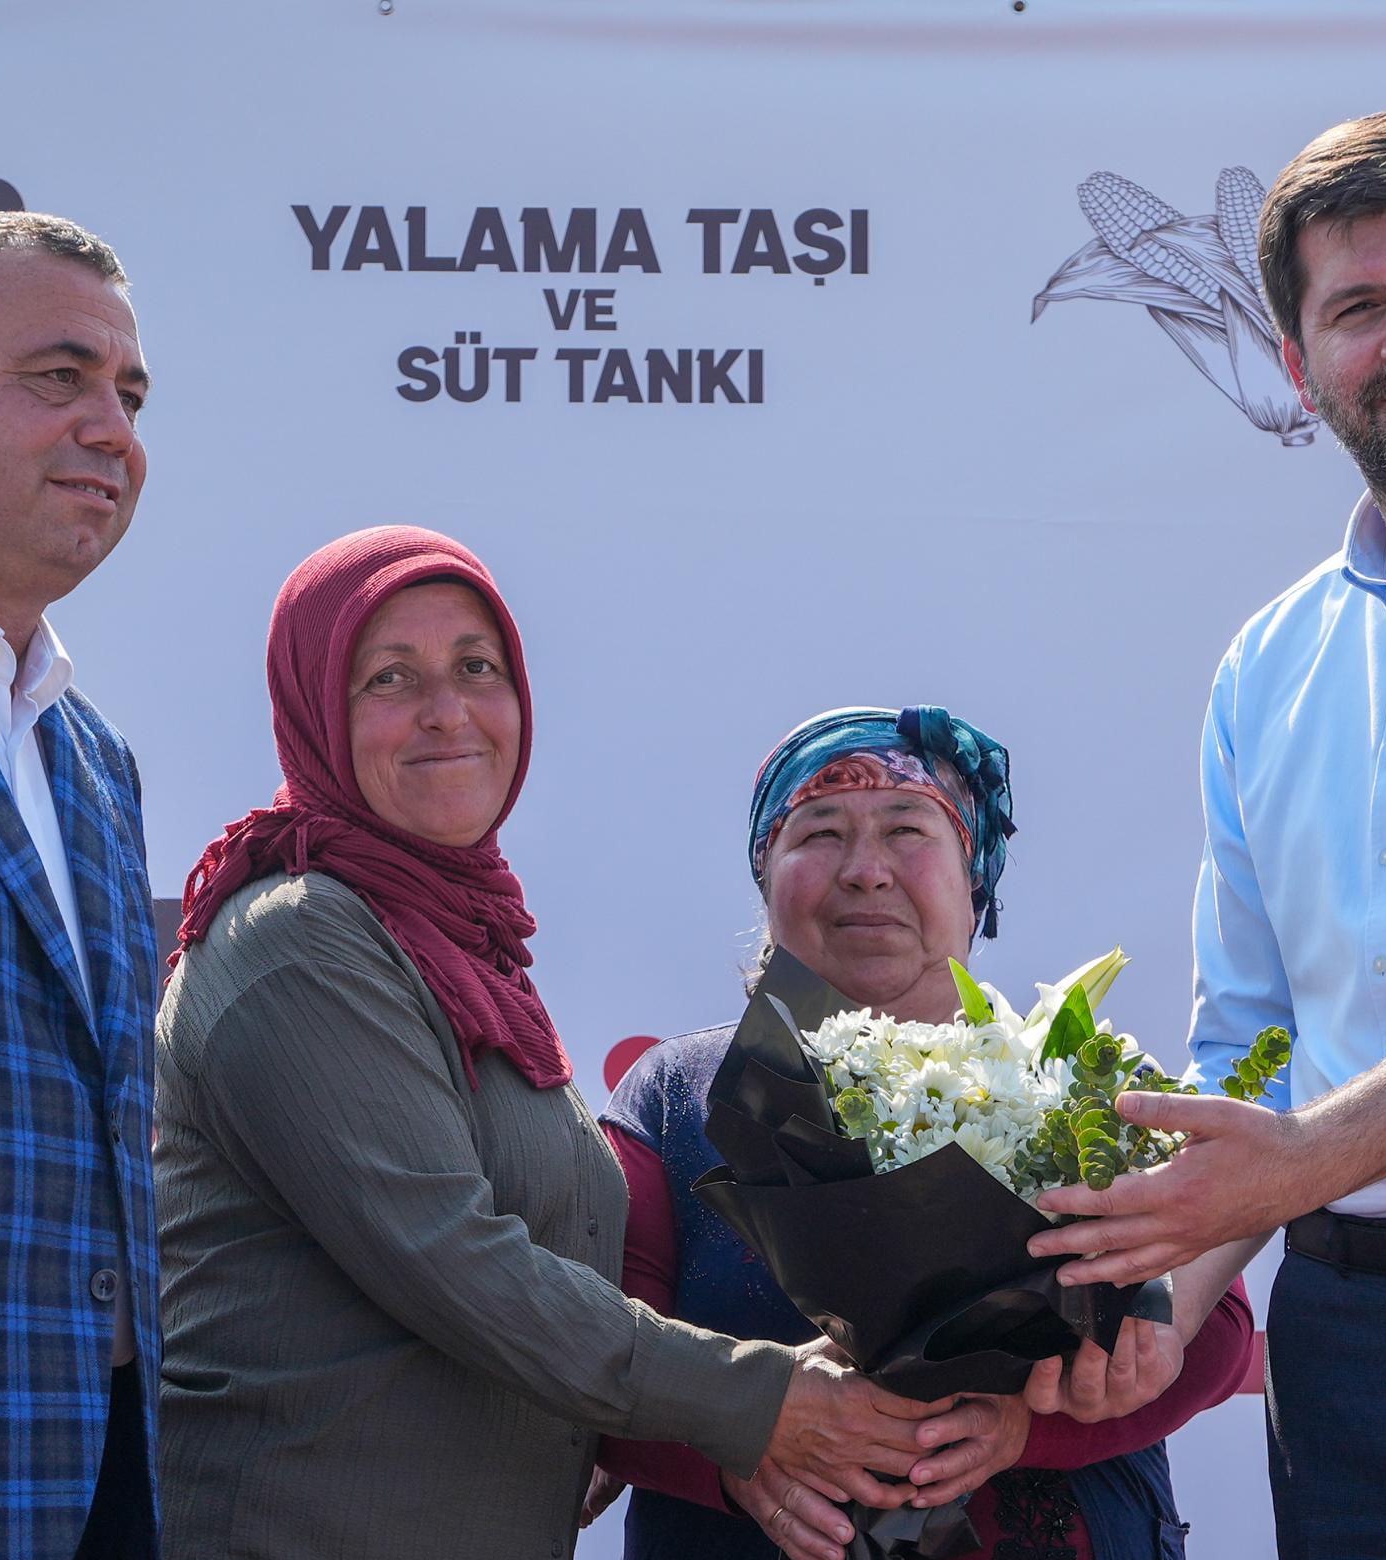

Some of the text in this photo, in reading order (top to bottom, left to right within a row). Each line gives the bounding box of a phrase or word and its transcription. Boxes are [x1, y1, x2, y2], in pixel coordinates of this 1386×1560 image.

[290, 205, 869, 287] YALAMA TAŞI
[543, 288, 618, 331] VE
[396, 331, 764, 404] SÜT TANKI
